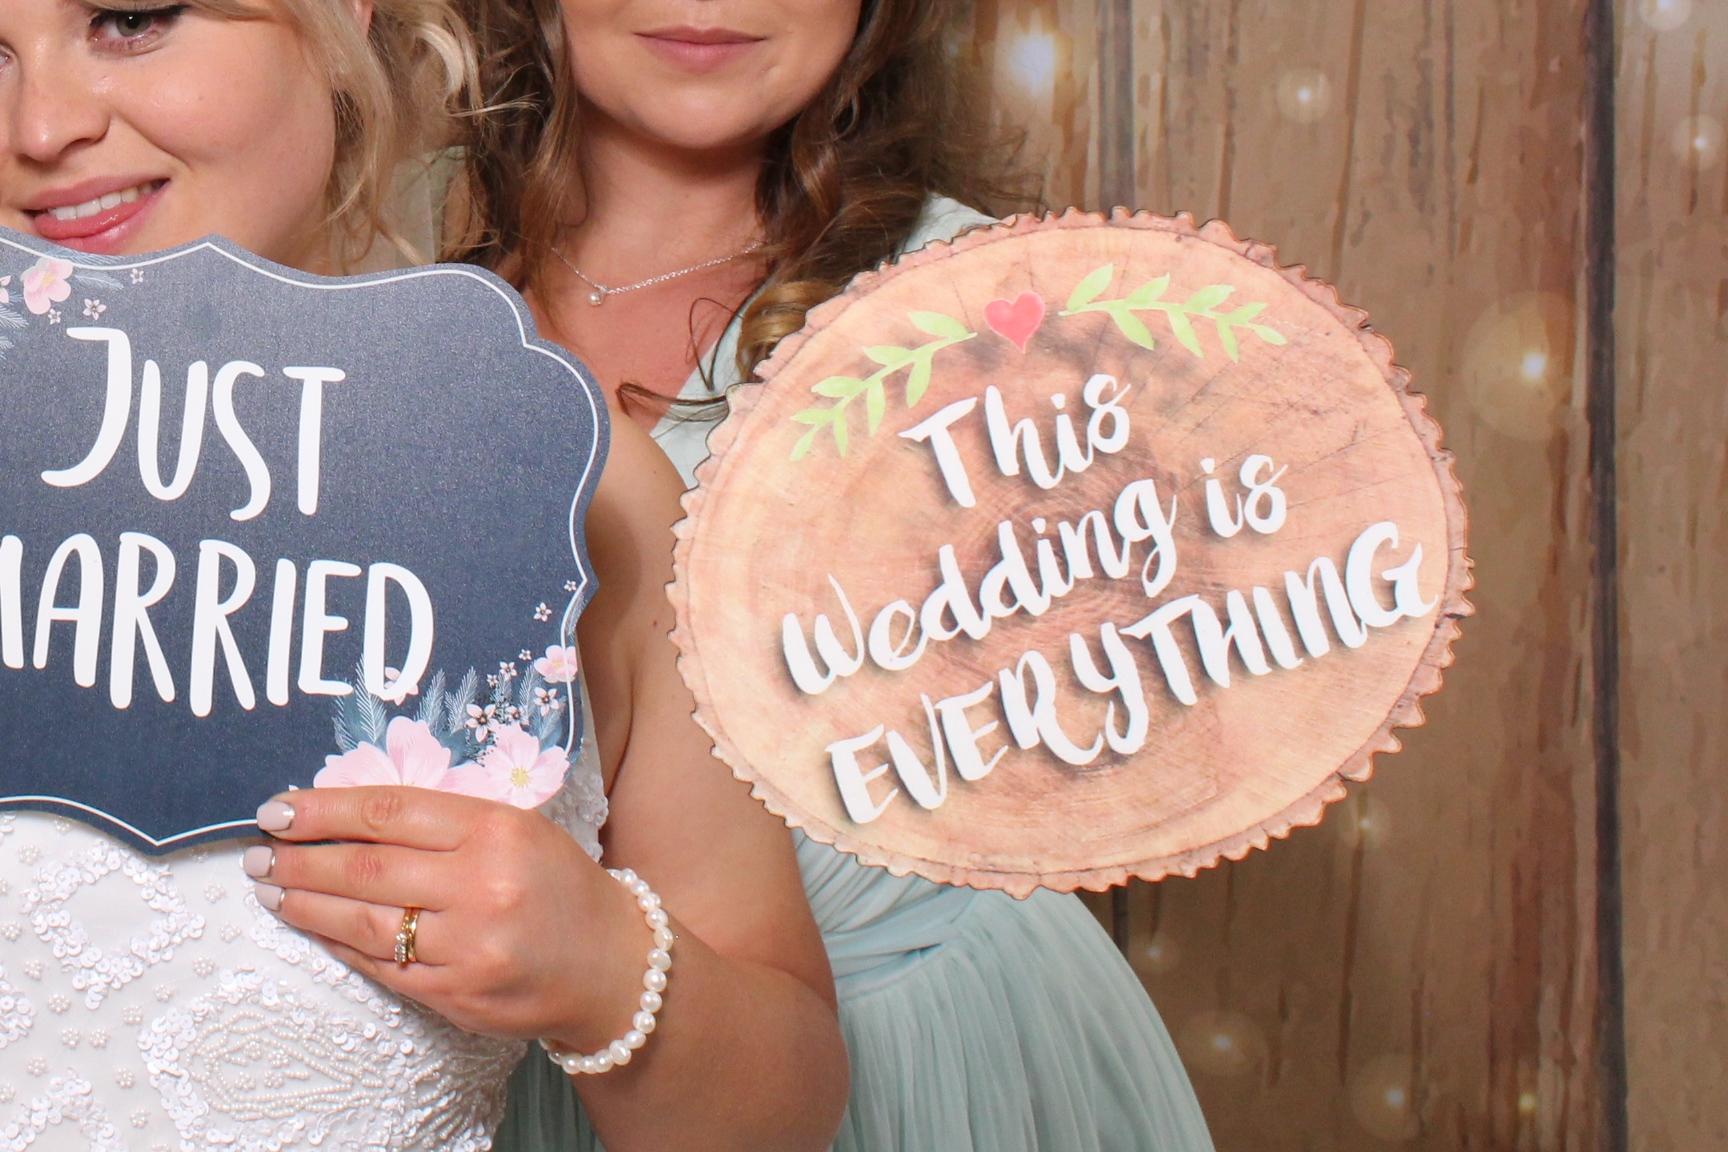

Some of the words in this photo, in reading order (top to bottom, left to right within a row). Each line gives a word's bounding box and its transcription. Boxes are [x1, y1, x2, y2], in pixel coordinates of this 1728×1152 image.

[40, 326, 347, 521] JUST
[898, 373, 1131, 508] This
[782, 478, 1177, 695] Wedding
[1205, 454, 1288, 538] is
[824, 521, 1438, 825] EVERYTHING
